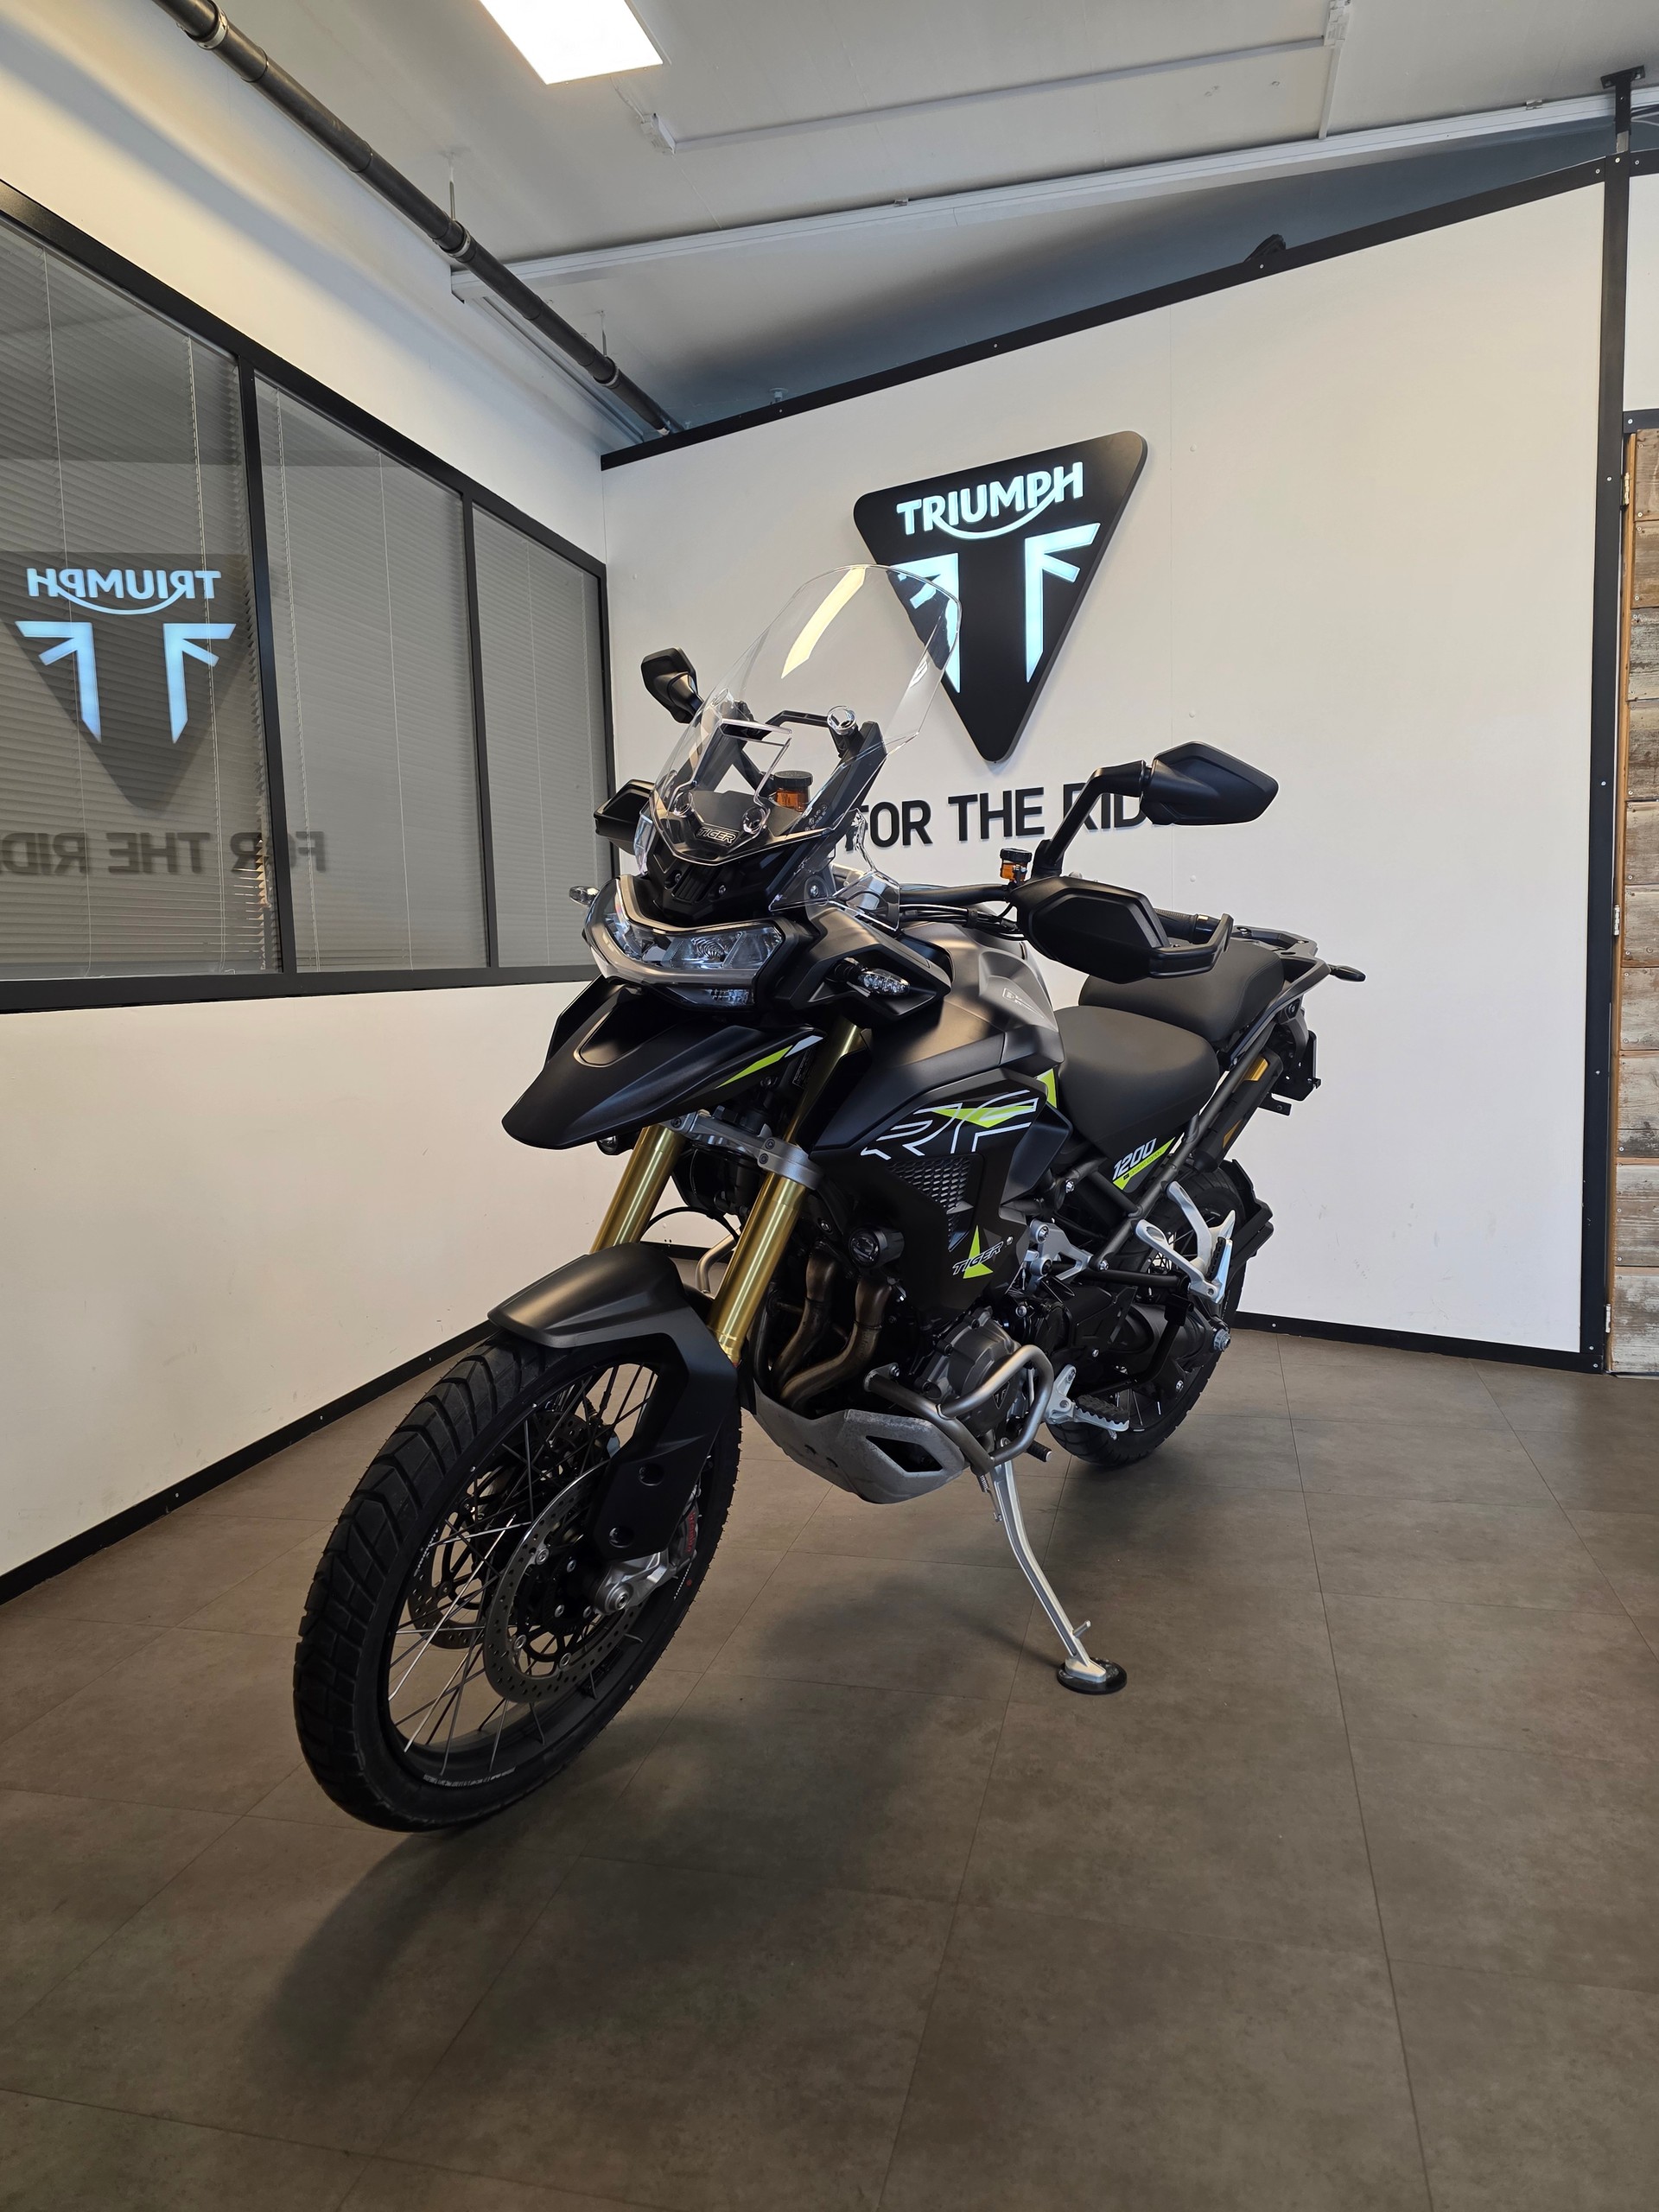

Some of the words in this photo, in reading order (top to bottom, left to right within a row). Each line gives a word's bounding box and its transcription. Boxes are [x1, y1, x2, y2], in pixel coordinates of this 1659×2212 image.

[896, 461, 1084, 539] TRIUMPH
[947, 786, 1045, 842] THE
[1063, 781, 1149, 830] RID
[698, 827, 737, 844] TIGER
[1112, 1137, 1157, 1181] 1200
[952, 1241, 1004, 1275] TIGER
